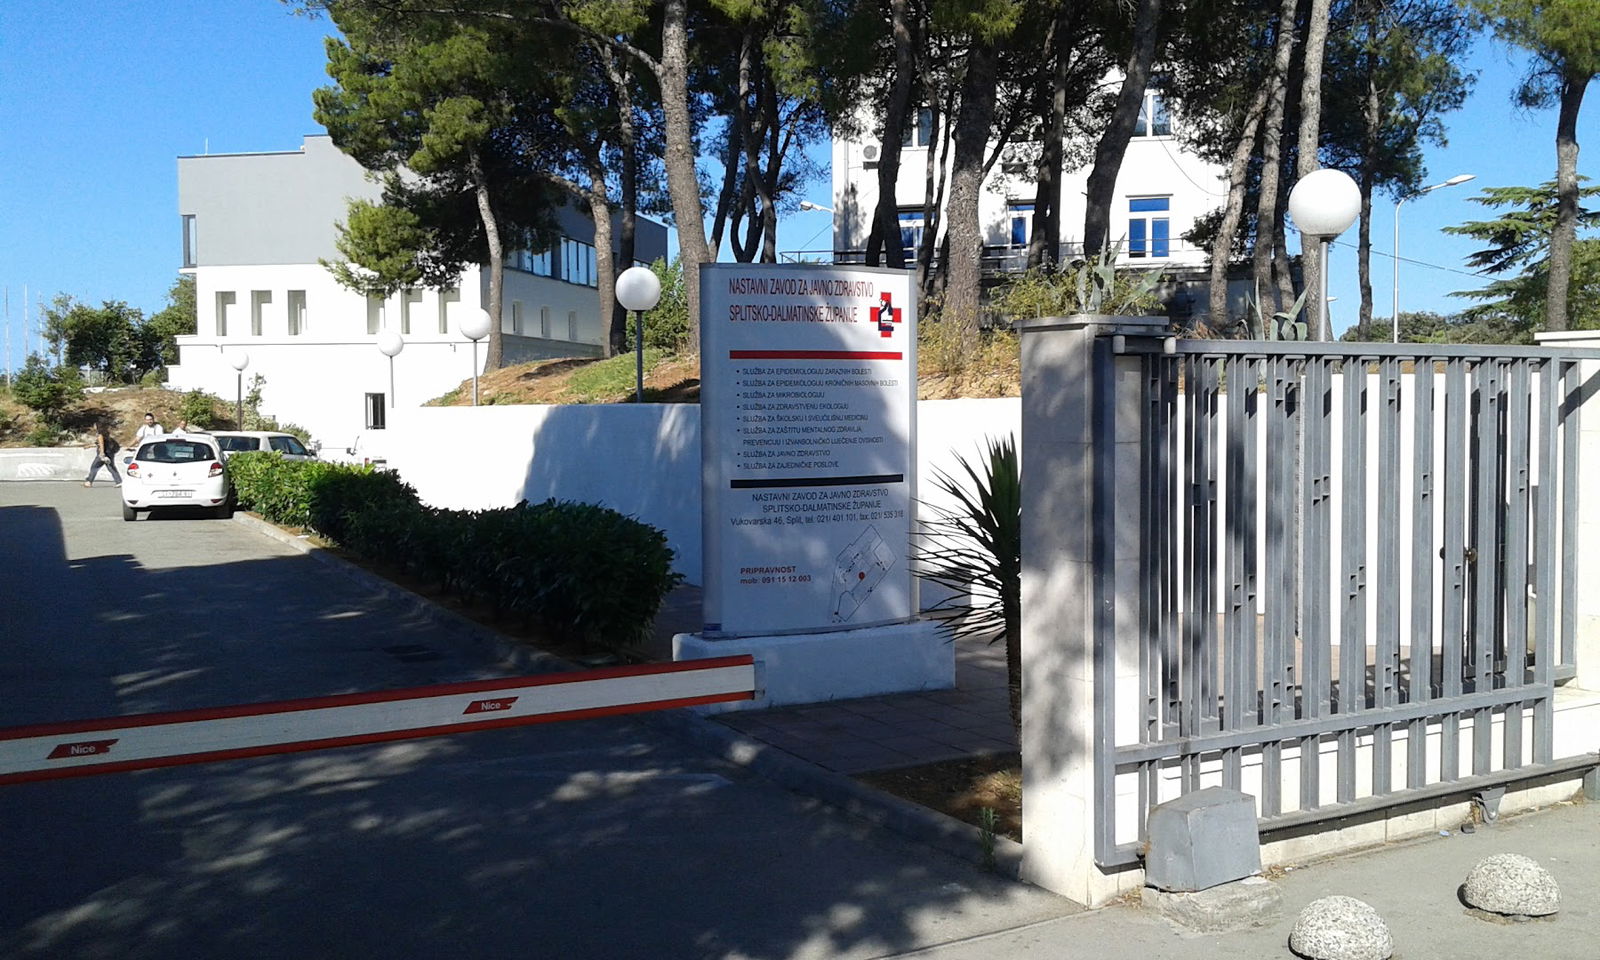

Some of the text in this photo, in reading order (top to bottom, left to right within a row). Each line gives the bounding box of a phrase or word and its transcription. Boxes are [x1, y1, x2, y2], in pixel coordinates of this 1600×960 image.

[728, 278, 874, 298] NASTAVNI ZAVOD ZA JAVNO ZDRAVSTVO
[729, 302, 858, 323] SPLITSKO-DALMATINSKE ŽUPANIJE
[742, 367, 766, 375] SLUŽBA
[742, 379, 766, 387] SLUŽBA
[825, 379, 853, 387] KRONIČNIH
[742, 391, 766, 399] SLUŽBA
[742, 403, 766, 411] SLUŽBA
[742, 414, 766, 422] SLUŽBA
[776, 413, 803, 422] ŠKOLSKU
[808, 414, 843, 422] SVEUČILIŠNU
[743, 426, 767, 434] SLUŽBA
[776, 426, 800, 434] ZAŠTITU
[801, 426, 836, 434] MENTALNOG
[785, 438, 830, 446] IZVANBOLNIČKO
[831, 436, 858, 445] LIJEČENJE
[858, 436, 884, 444] OVISNOSTI
[743, 450, 767, 458] SLUŽBA
[797, 449, 831, 457] ZDRAVSTVO
[743, 462, 767, 470] SLUŽBA
[776, 461, 812, 469] ZAJEDNIČKE
[813, 460, 839, 468] POSLOVE
[752, 488, 888, 502] NASTAVNI ZAVOD ZA JAVNO ZDRAVSTVO
[762, 499, 881, 513] SPLITSKO-DALMATINSKE ŽUPANIJE
[730, 518, 772, 526] Vukovarska
[833, 512, 844, 522] 401
[883, 509, 894, 519] 535
[740, 565, 796, 575] PRIPRAVNOST
[761, 576, 775, 584] 091
[788, 575, 796, 583] 12
[798, 574, 812, 582] 003
[481, 701, 501, 711] Nice
[70, 744, 96, 755] Nice
